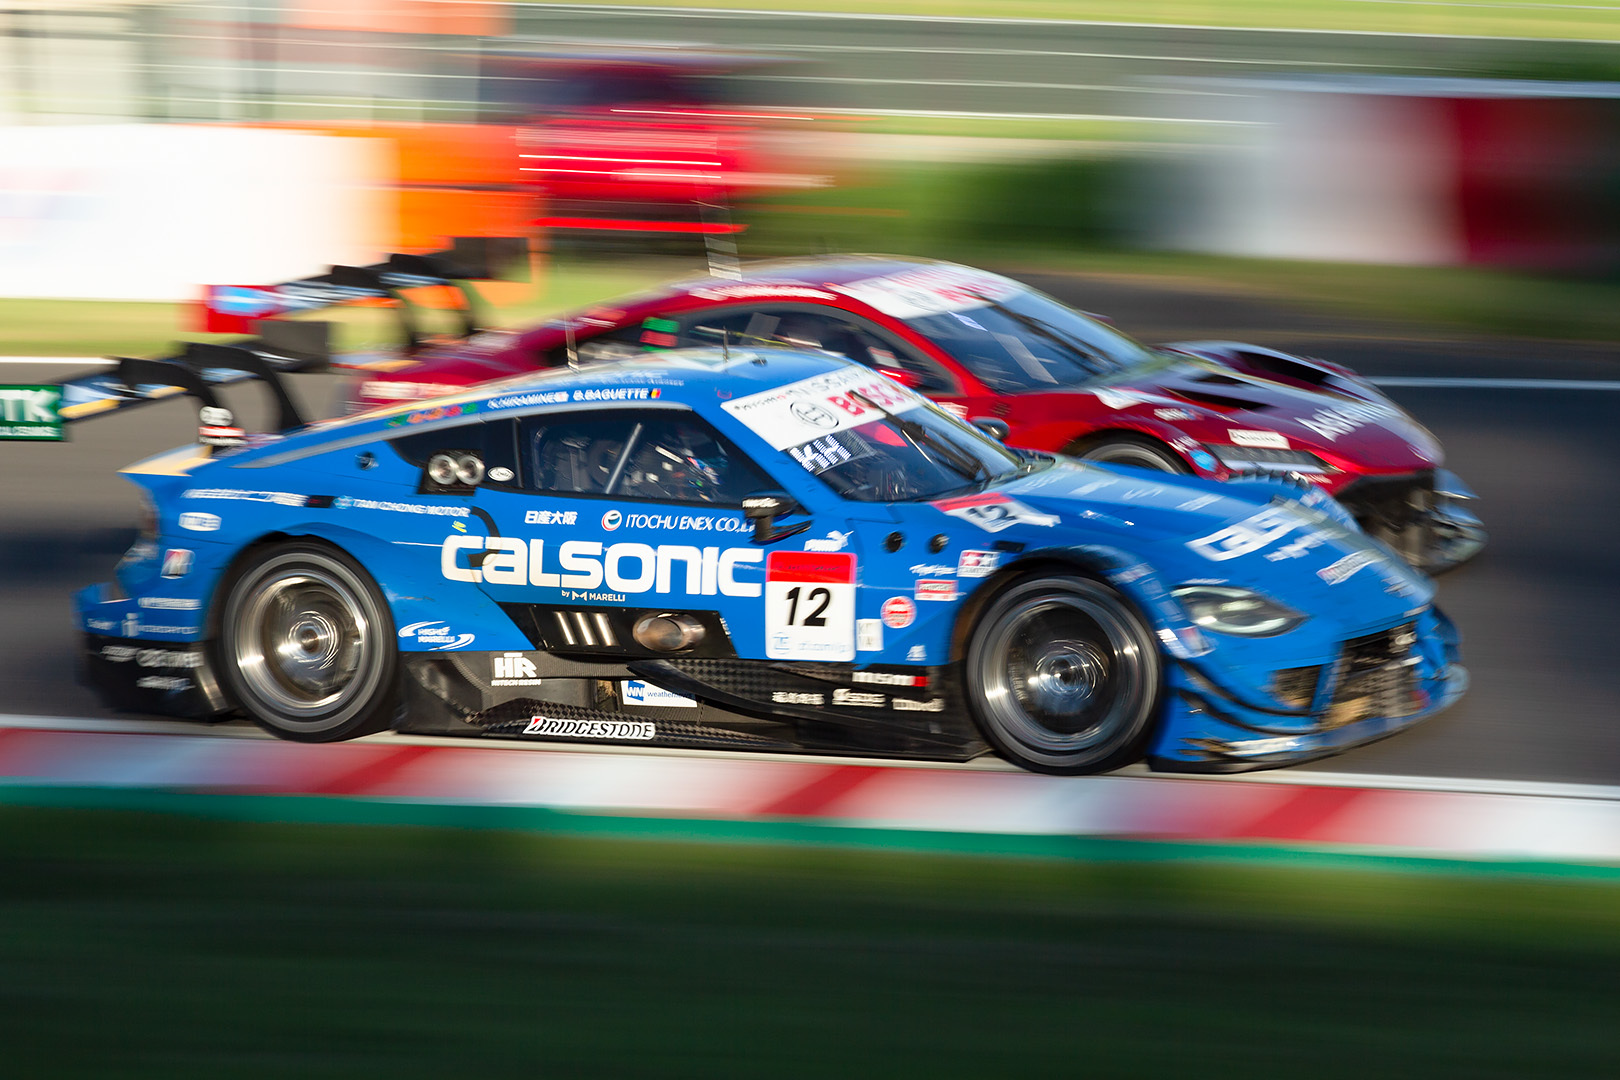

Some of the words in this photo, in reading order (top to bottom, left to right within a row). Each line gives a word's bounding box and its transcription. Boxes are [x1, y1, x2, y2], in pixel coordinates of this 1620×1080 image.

[525, 510, 578, 525] 日産大阪
[626, 513, 680, 529] ITOCHU
[679, 515, 716, 530] ENEX
[589, 593, 626, 602] MARELLI
[785, 586, 832, 627] 12
[529, 717, 653, 738] BRIDGESTONE
